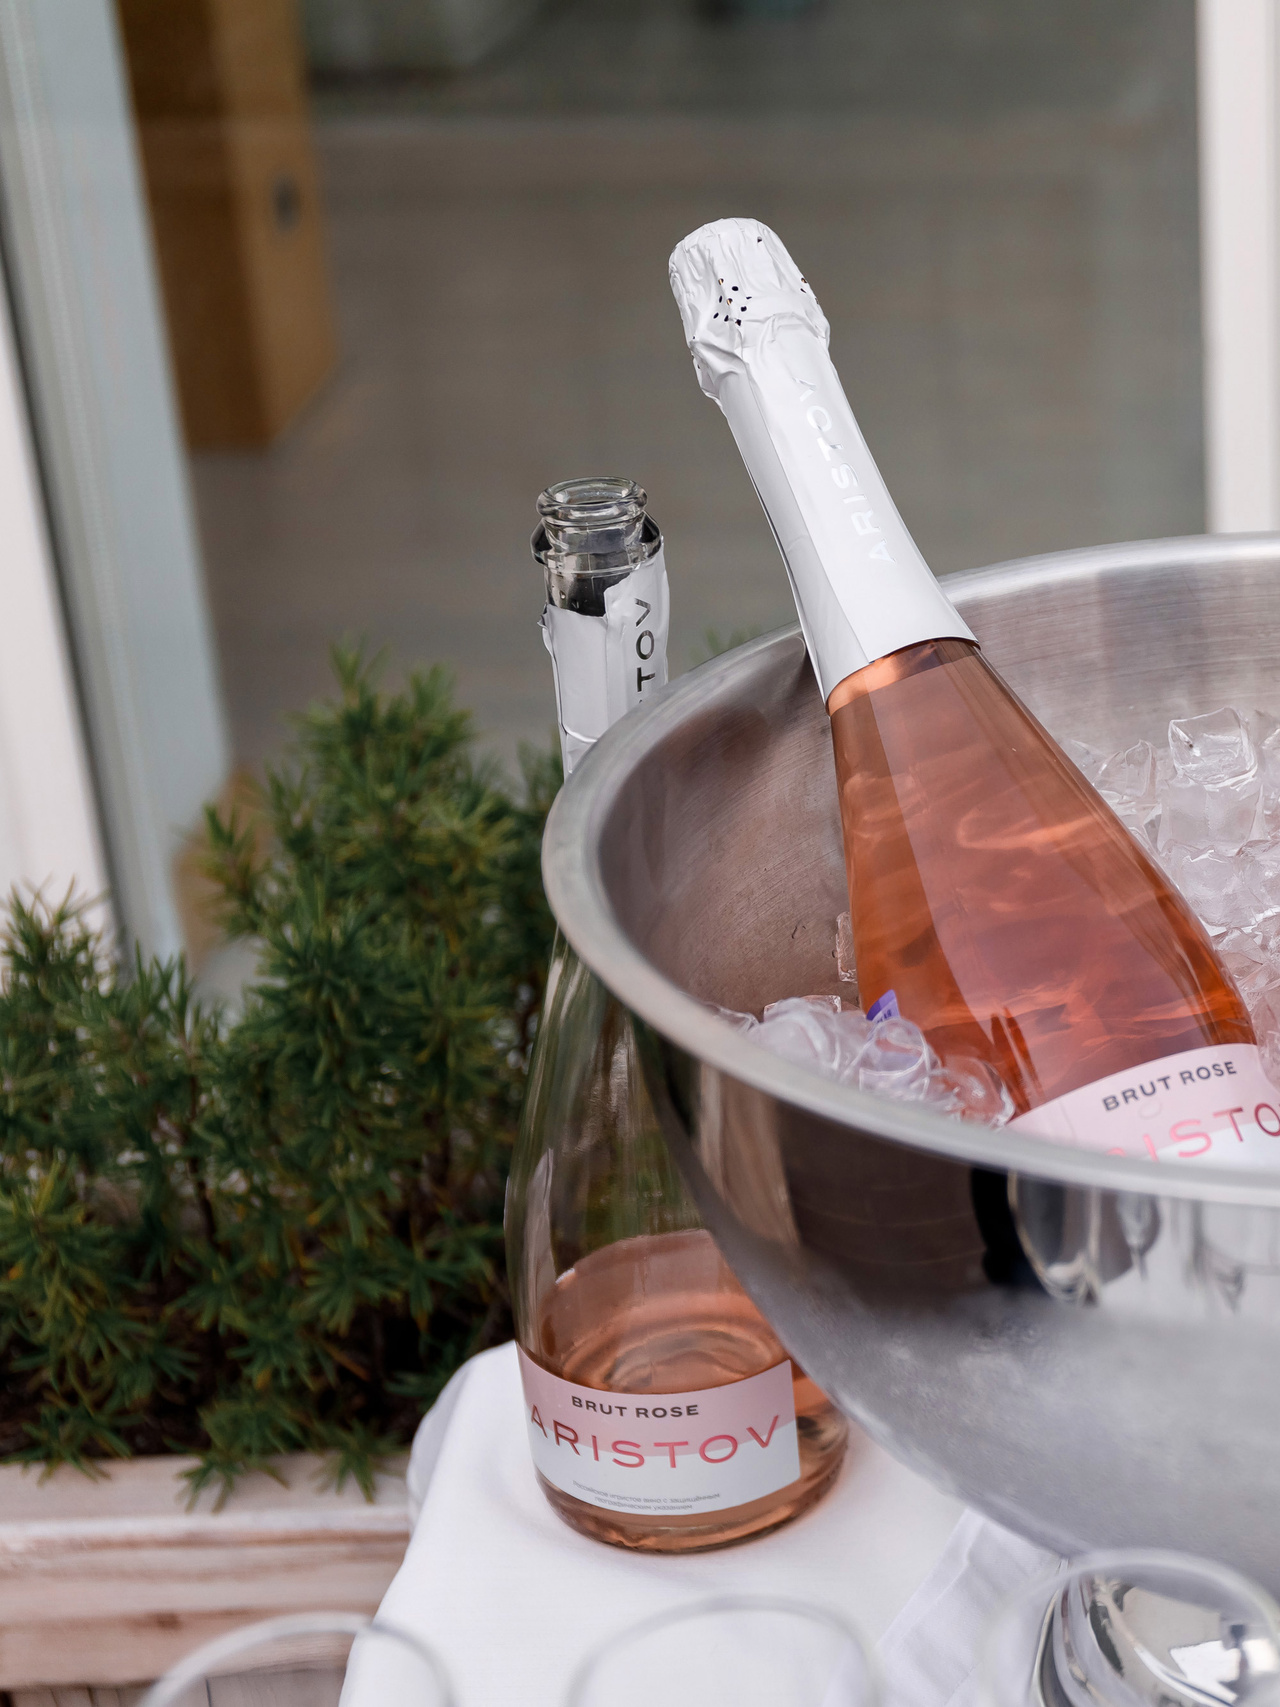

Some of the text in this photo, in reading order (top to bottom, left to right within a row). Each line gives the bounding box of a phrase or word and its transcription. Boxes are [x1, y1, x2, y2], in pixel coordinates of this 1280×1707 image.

[793, 377, 896, 566] ARISTOV
[1102, 1061, 1237, 1112] BRUT ROSE
[571, 1396, 699, 1418] BRUT ROSE
[530, 1404, 780, 1469] ARISTOV
